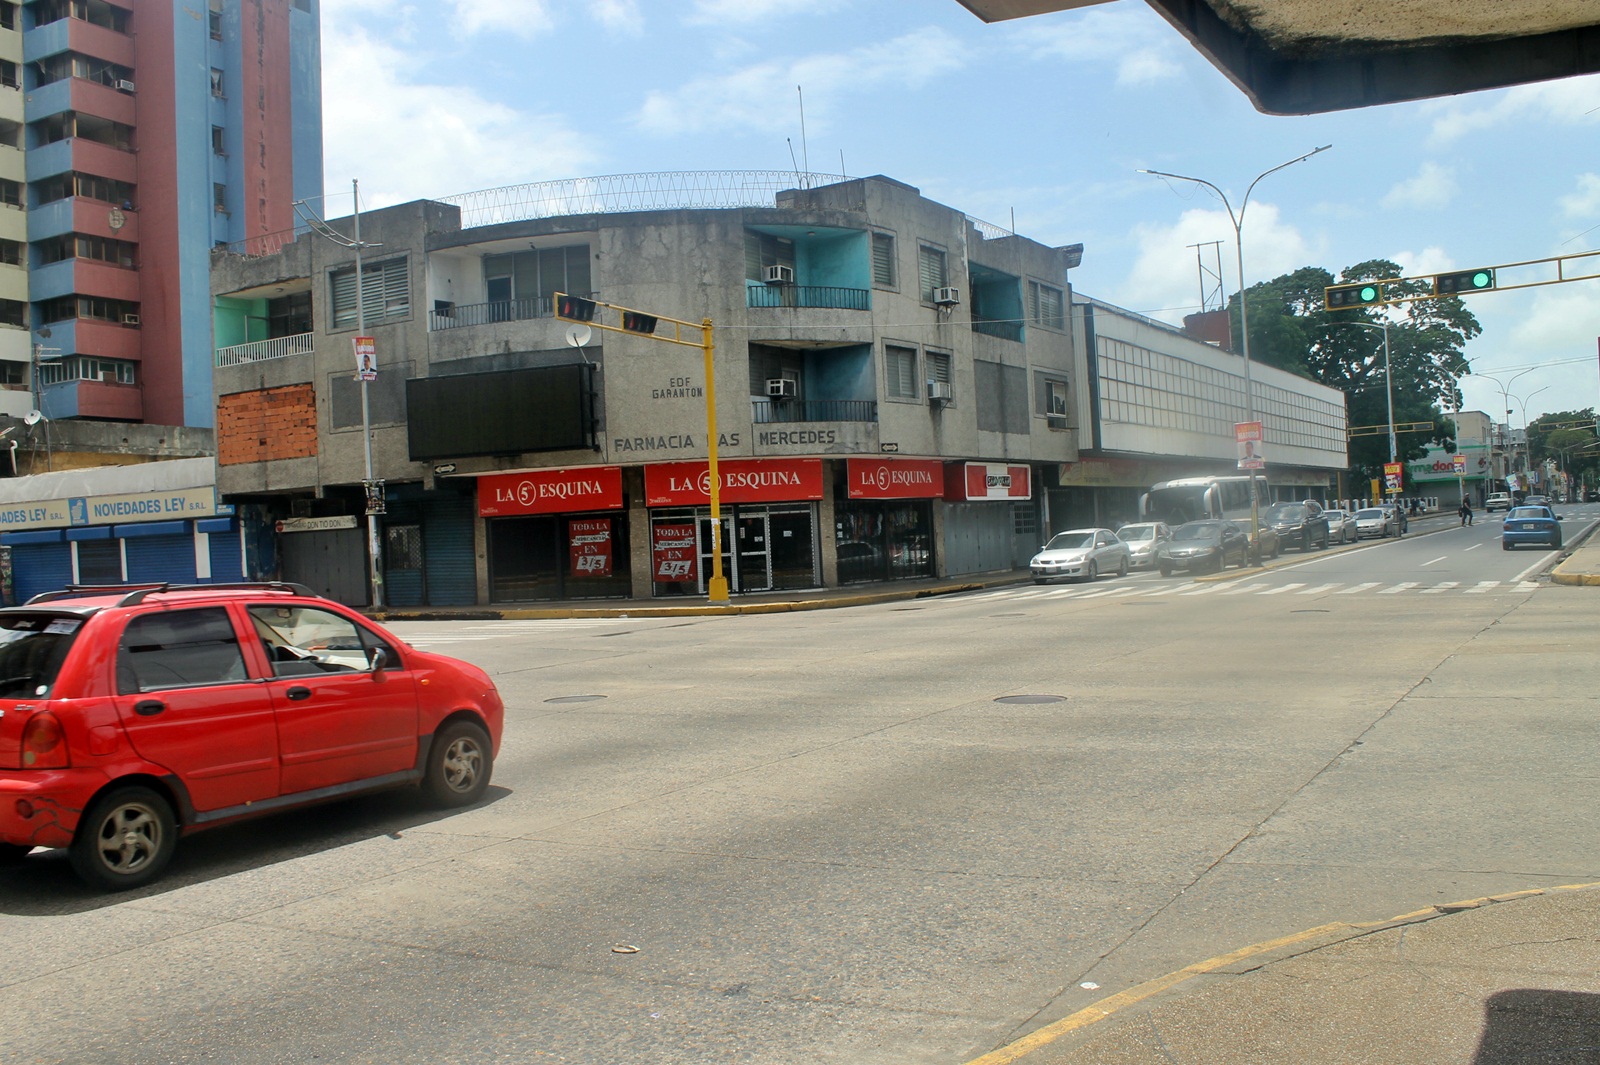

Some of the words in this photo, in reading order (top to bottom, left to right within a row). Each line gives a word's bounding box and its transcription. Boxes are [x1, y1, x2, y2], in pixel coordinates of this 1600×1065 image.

[669, 377, 691, 388] EDF
[652, 387, 703, 399] GARANTON
[614, 435, 694, 452] FARMACIA
[707, 433, 740, 447] AS
[759, 430, 836, 446] MERCEDES
[668, 477, 694, 492] LA
[726, 471, 801, 488] ESQUINA
[861, 471, 876, 485] LA
[891, 470, 933, 486] ESQUINA
[496, 488, 515, 502] LA
[539, 480, 603, 499] ESQUINA
[93, 499, 161, 517] NOVEDADES
[164, 497, 185, 512] LEY
[0, 510, 26, 524] ADES
[28, 508, 47, 522] LEY
[572, 523, 595, 531] TODA
[596, 522, 608, 530] LA
[655, 528, 680, 537] TODA
[584, 545, 598, 554] EN
[668, 550, 683, 559] EN
[581, 556, 602, 569] 3/5
[664, 562, 686, 574] 3/5
